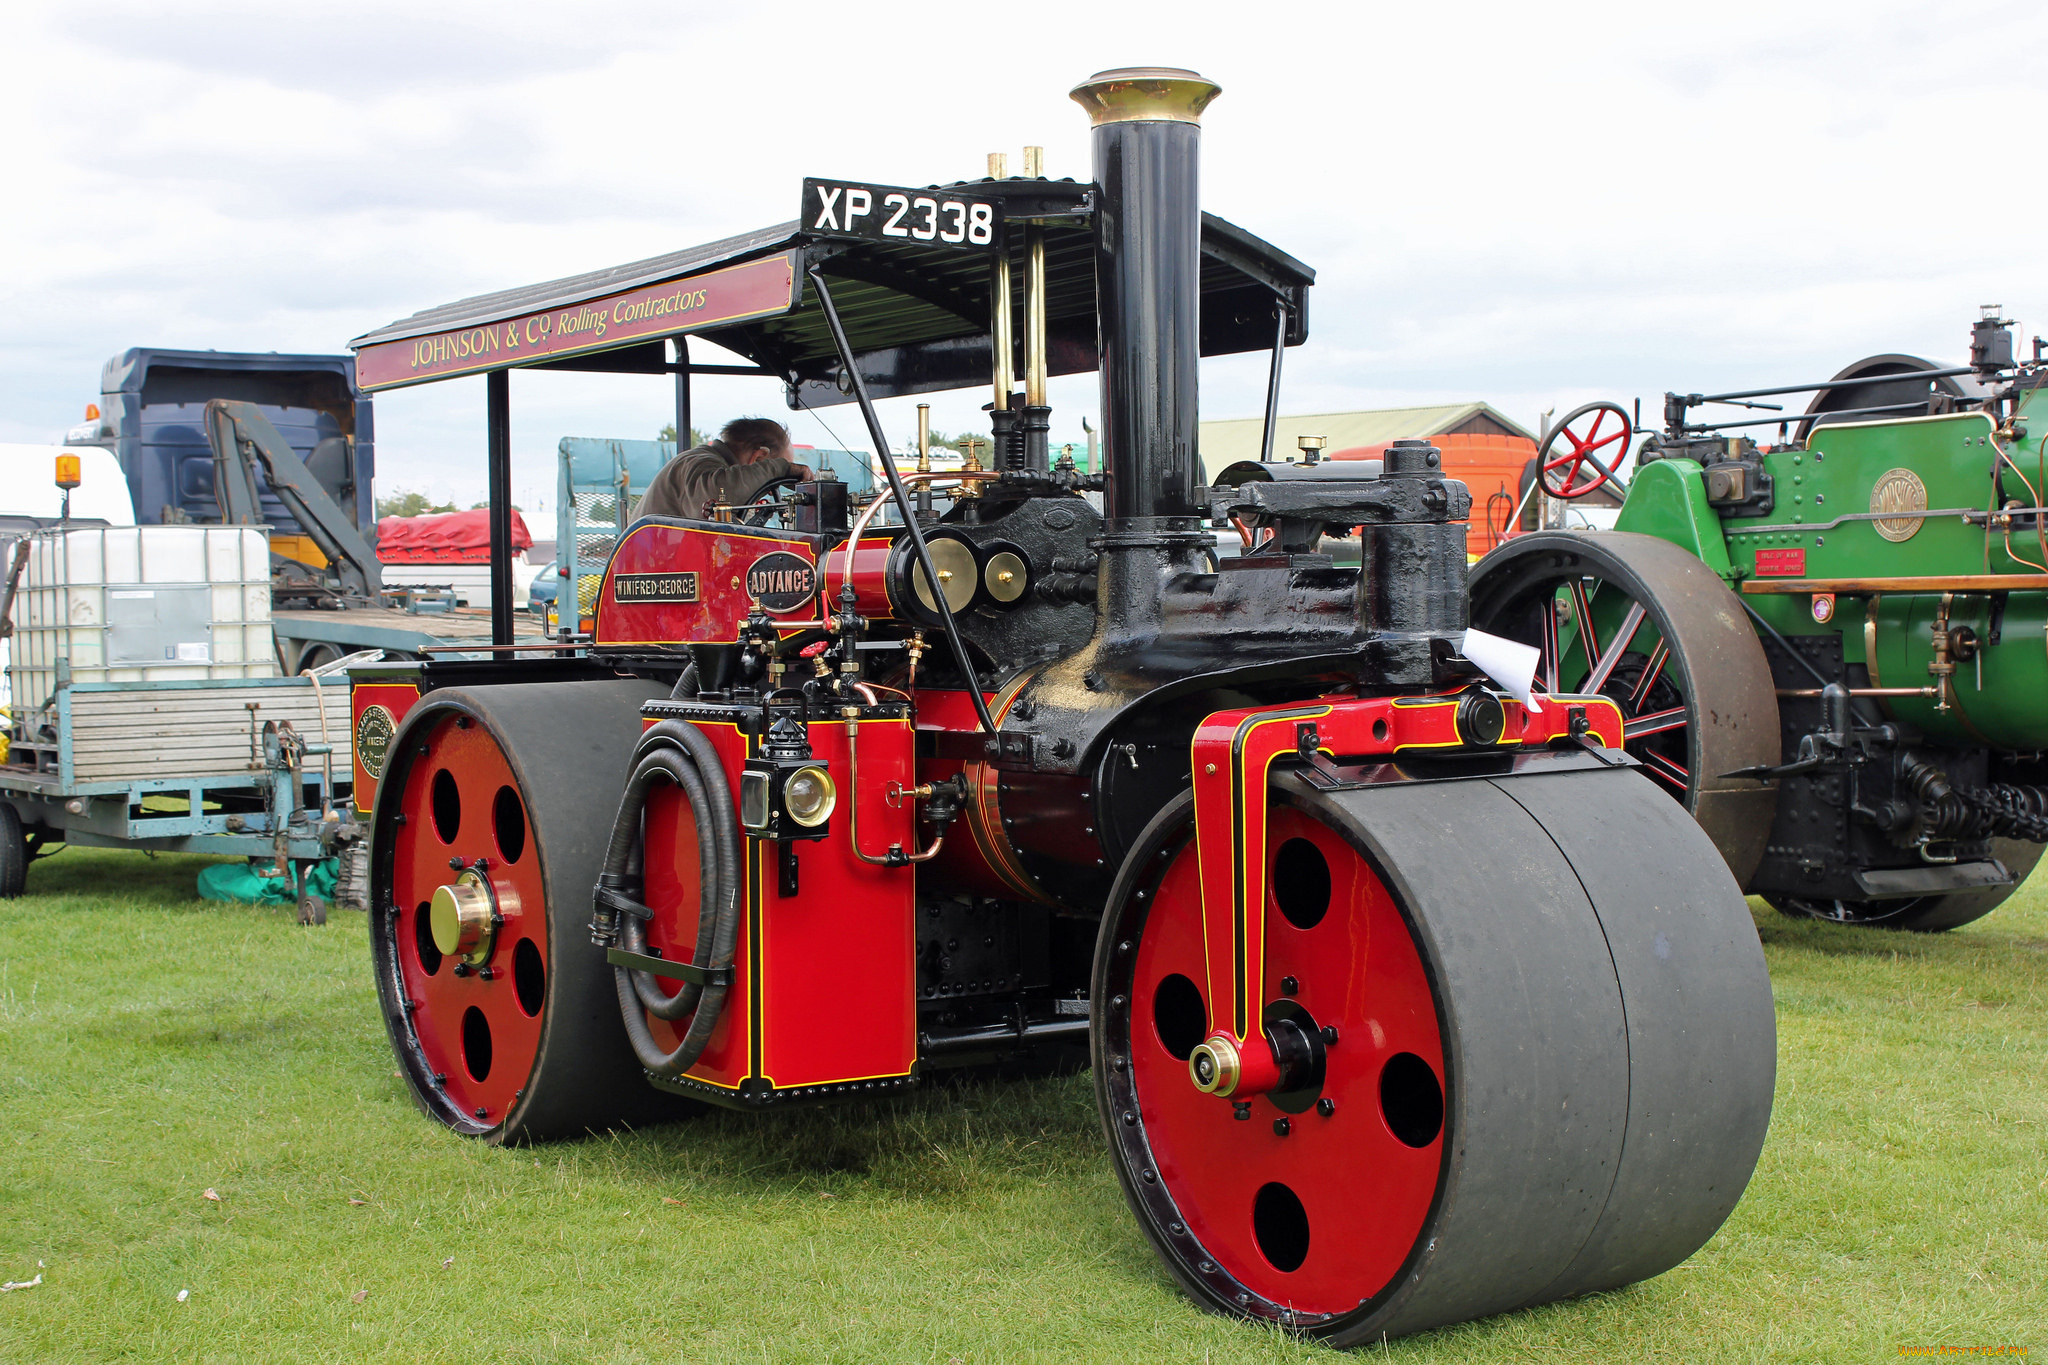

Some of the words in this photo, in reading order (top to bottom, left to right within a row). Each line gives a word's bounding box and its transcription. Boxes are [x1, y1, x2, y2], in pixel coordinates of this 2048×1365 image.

[814, 185, 872, 232] XP
[882, 193, 993, 245] 2338
[411, 324, 500, 369] JOHNSON
[506, 321, 519, 347] &
[558, 308, 608, 338] Rolling
[613, 287, 707, 324] Contractors
[750, 568, 810, 593] ADVANCE
